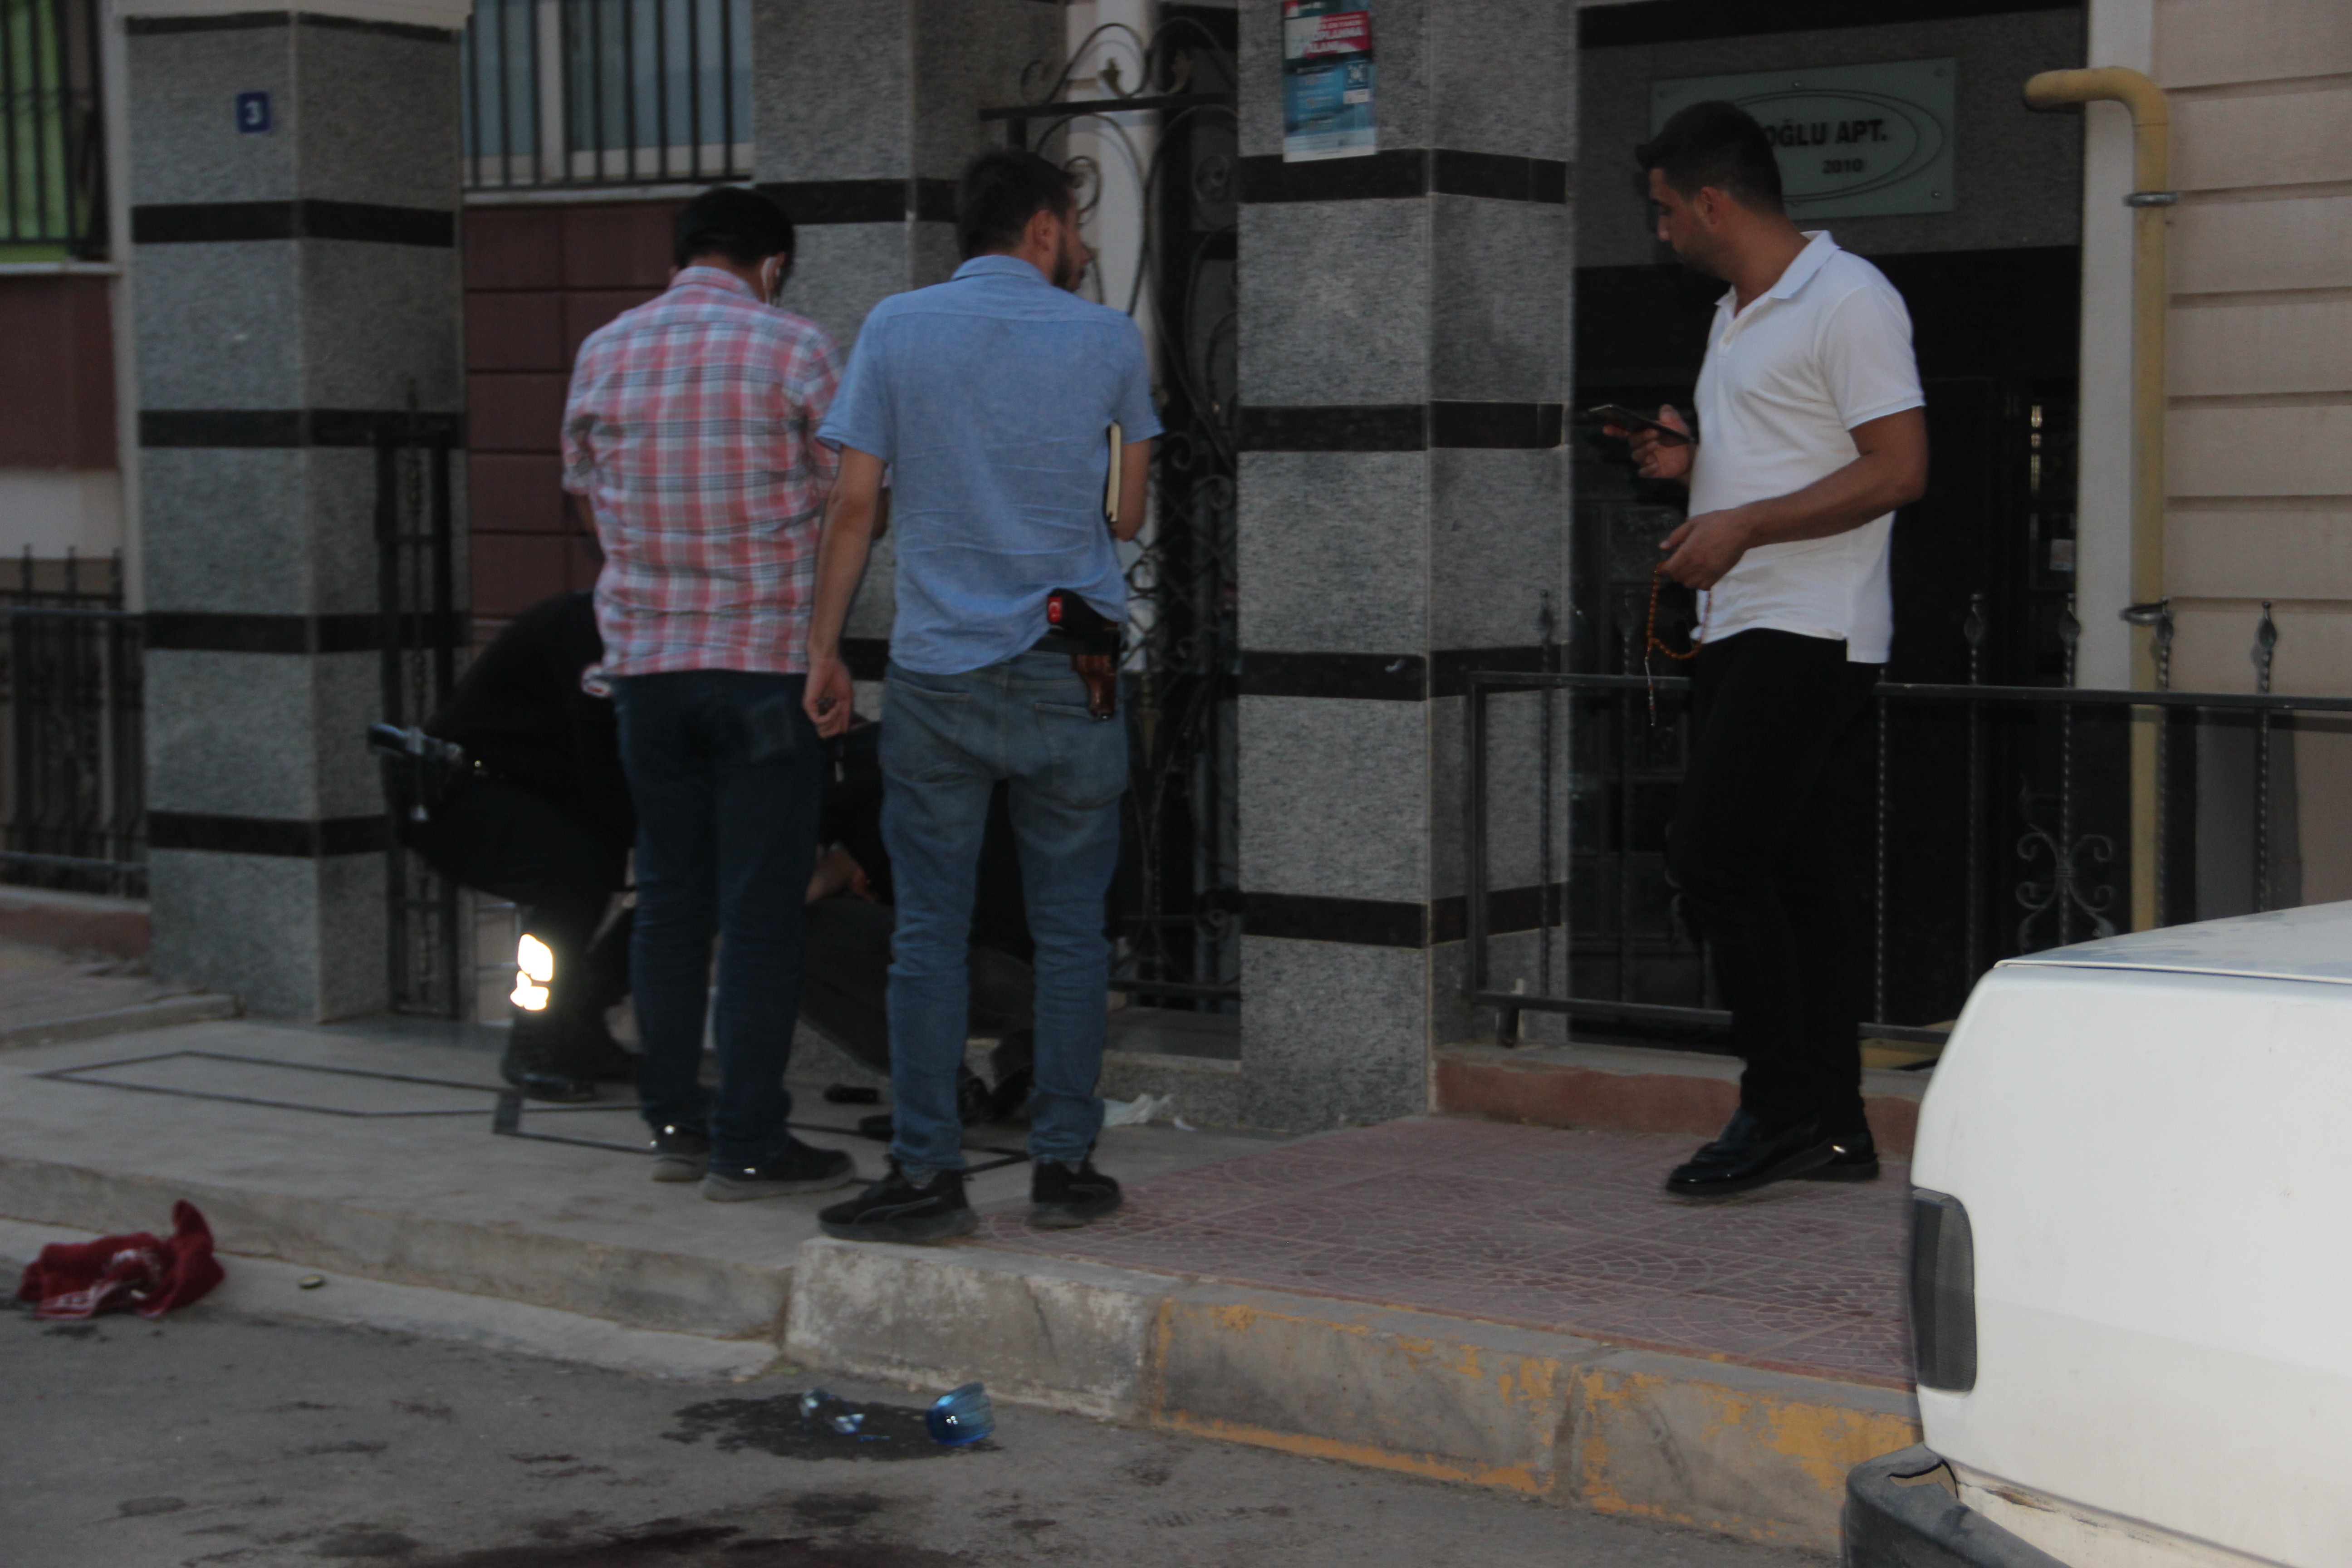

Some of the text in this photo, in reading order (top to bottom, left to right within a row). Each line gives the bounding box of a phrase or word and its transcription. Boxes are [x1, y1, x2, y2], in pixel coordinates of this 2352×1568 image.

[245, 101, 262, 125] 3
[1763, 118, 1888, 147] OĞLU APT.
[1822, 159, 1864, 174] 2010
